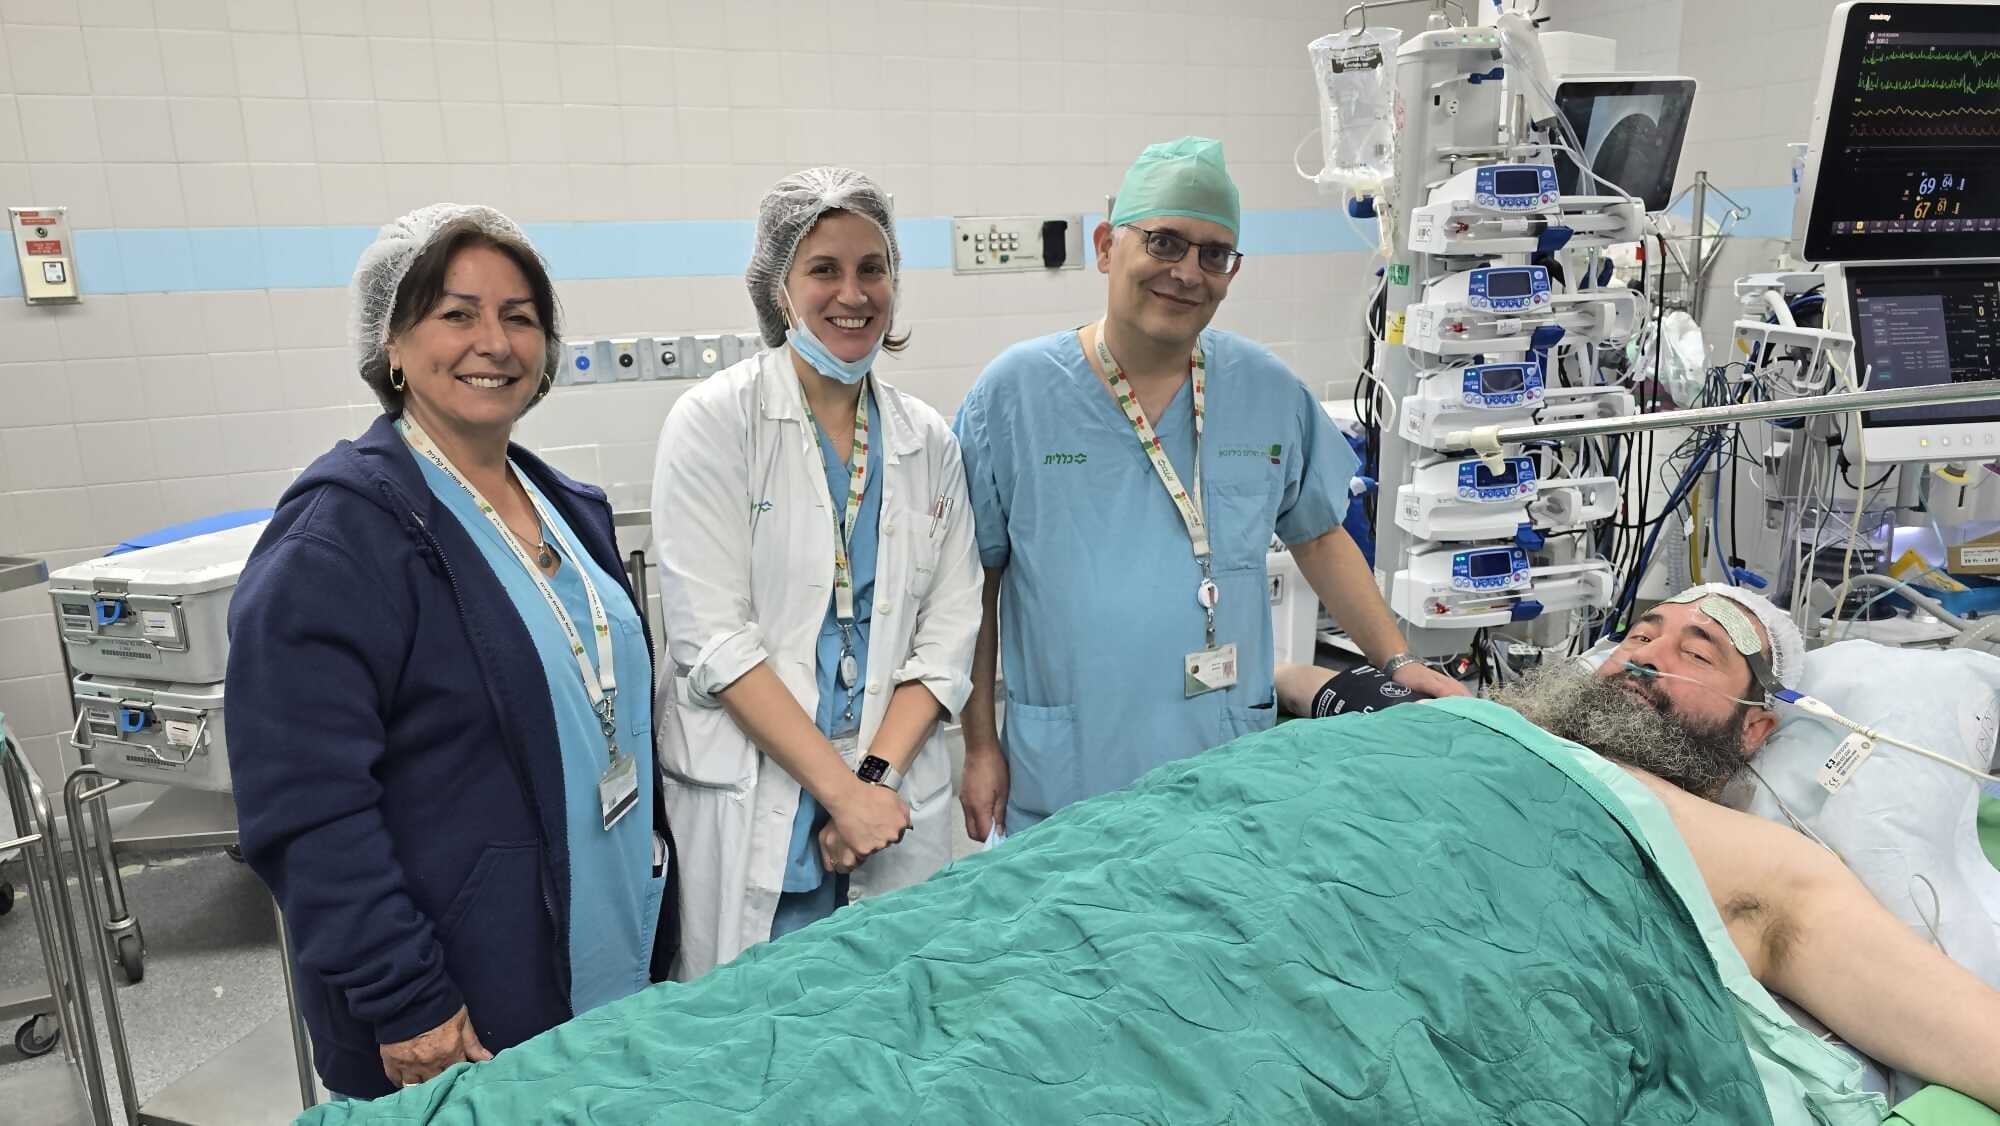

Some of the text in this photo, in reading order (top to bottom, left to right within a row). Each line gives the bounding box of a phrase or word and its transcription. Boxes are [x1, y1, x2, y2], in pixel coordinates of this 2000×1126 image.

[1919, 176, 1953, 195] 69 64
[1914, 201, 1931, 219] 67
[1042, 452, 1074, 465] כללית
